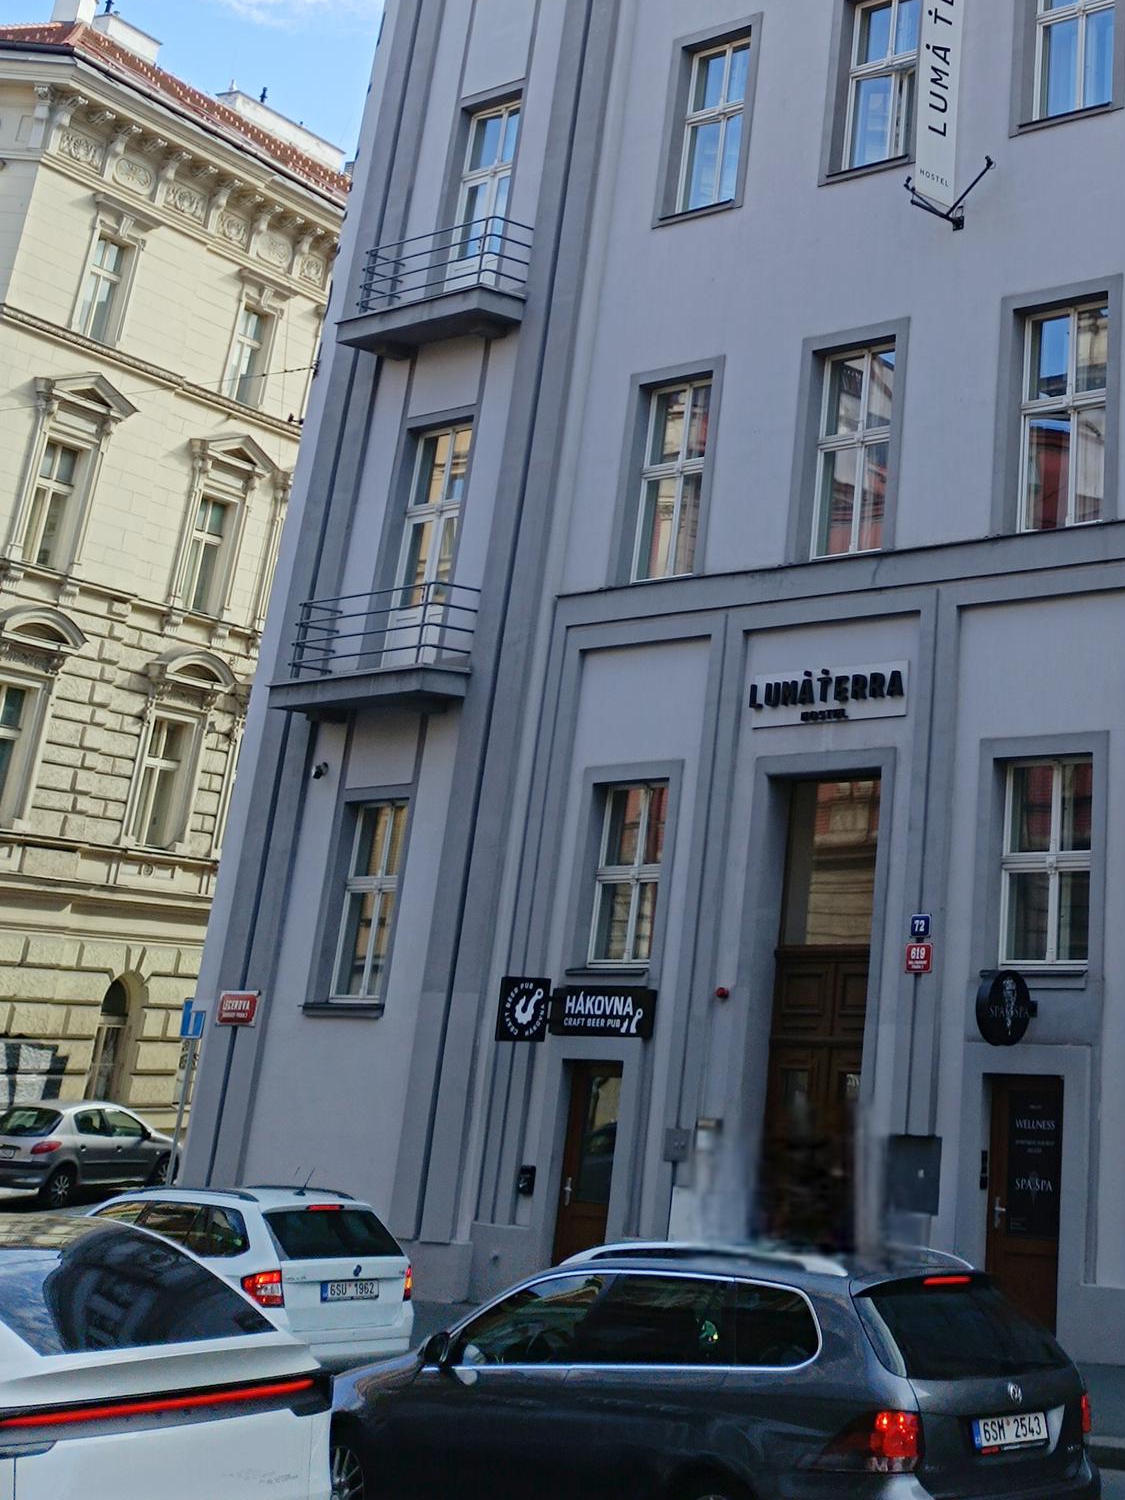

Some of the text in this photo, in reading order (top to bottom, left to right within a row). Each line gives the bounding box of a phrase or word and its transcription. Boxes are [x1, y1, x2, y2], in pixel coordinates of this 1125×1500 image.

[919, 169, 950, 187] HOSTEL
[800, 708, 849, 722] HOSTEL
[913, 919, 926, 932] 72
[910, 947, 926, 960] 619
[564, 990, 634, 1016] HÁKOVNA
[563, 1017, 621, 1028] CRAFT BEER PUB
[1015, 1118, 1056, 1130] WELLNESS
[1015, 1178, 1053, 1192] SPA SPA
[330, 1283, 375, 1296] 6SU 1962
[983, 1416, 1042, 1442] 6SM 2543
